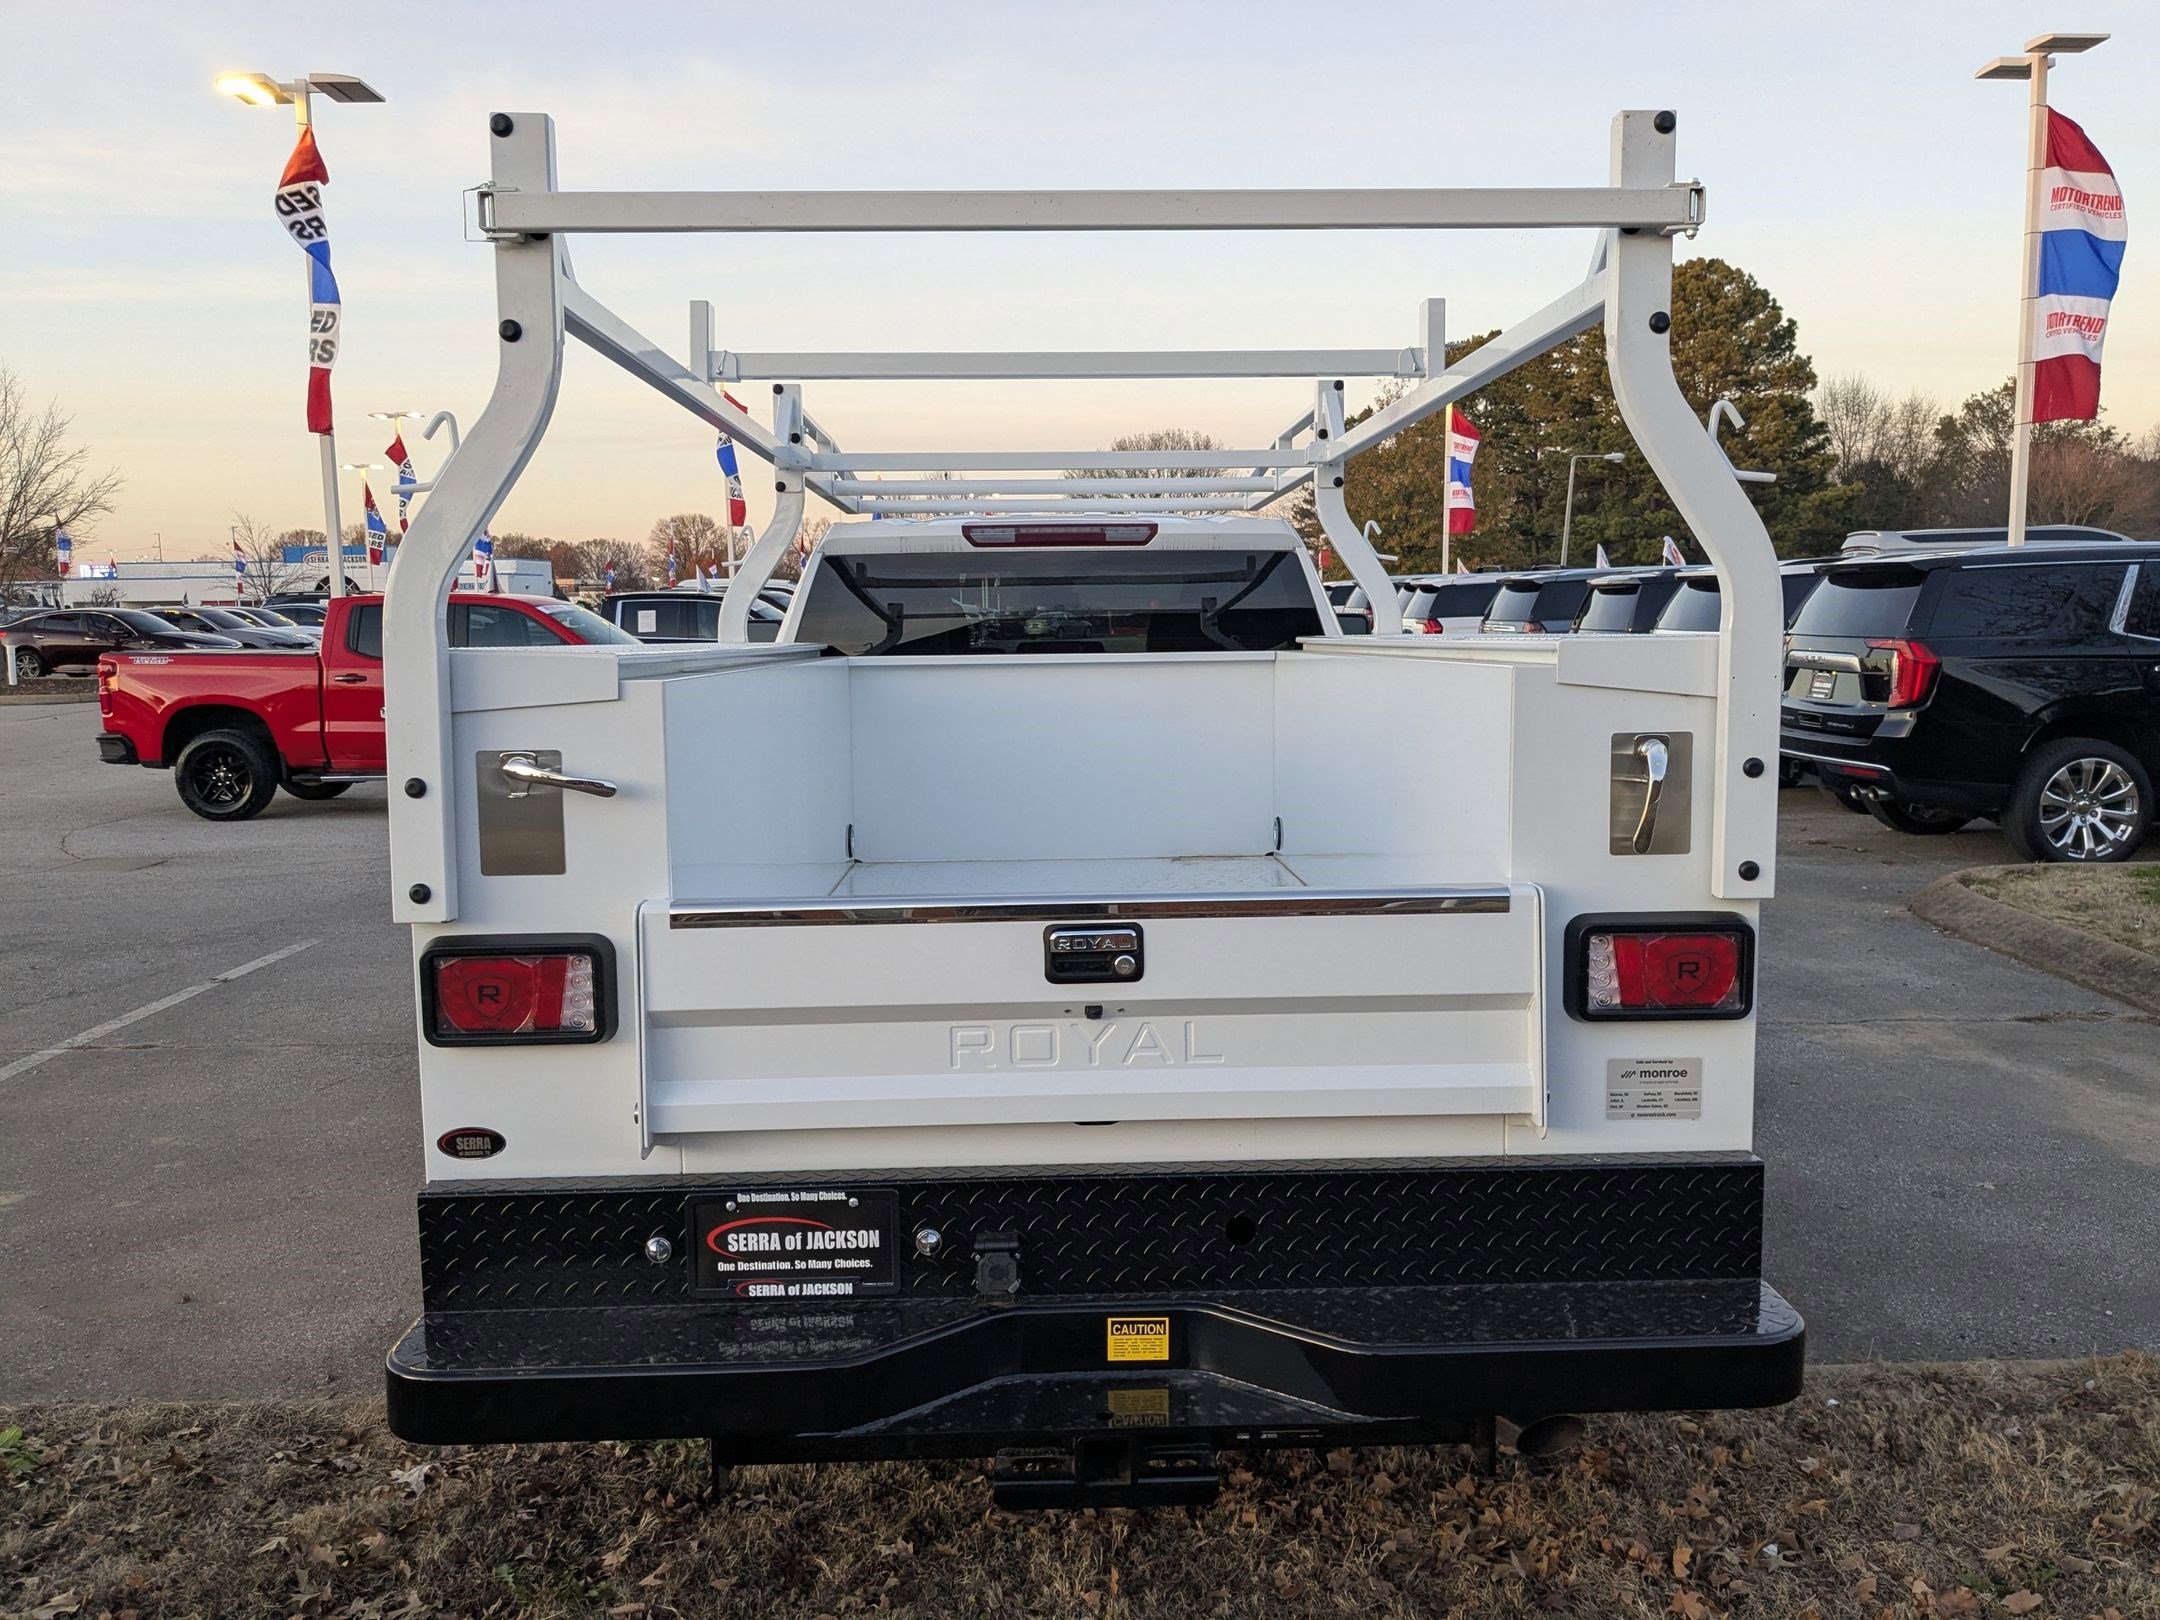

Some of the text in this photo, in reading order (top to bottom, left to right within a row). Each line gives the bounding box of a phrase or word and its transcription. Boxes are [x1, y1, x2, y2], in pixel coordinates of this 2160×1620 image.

[2050, 186, 2123, 211] MOTORTREND
[2050, 203, 2123, 219] CERTIFIED VEHICLES
[1057, 937, 1132, 950] ROYAL
[1677, 961, 1700, 980] R
[478, 985, 500, 1004] R
[950, 1021, 1225, 1069] ROYAL
[1640, 1069, 1688, 1078] monroe
[456, 1137, 492, 1150] SERRA
[737, 1191, 847, 1203] One Destination. So Many Choices.
[727, 1230, 880, 1252] SERRA of JACKSON
[718, 1258, 873, 1271] One Destination. So Many Choices.
[748, 1283, 853, 1297] SERRA of JACKSON
[1112, 1324, 1164, 1335] CAUTION
